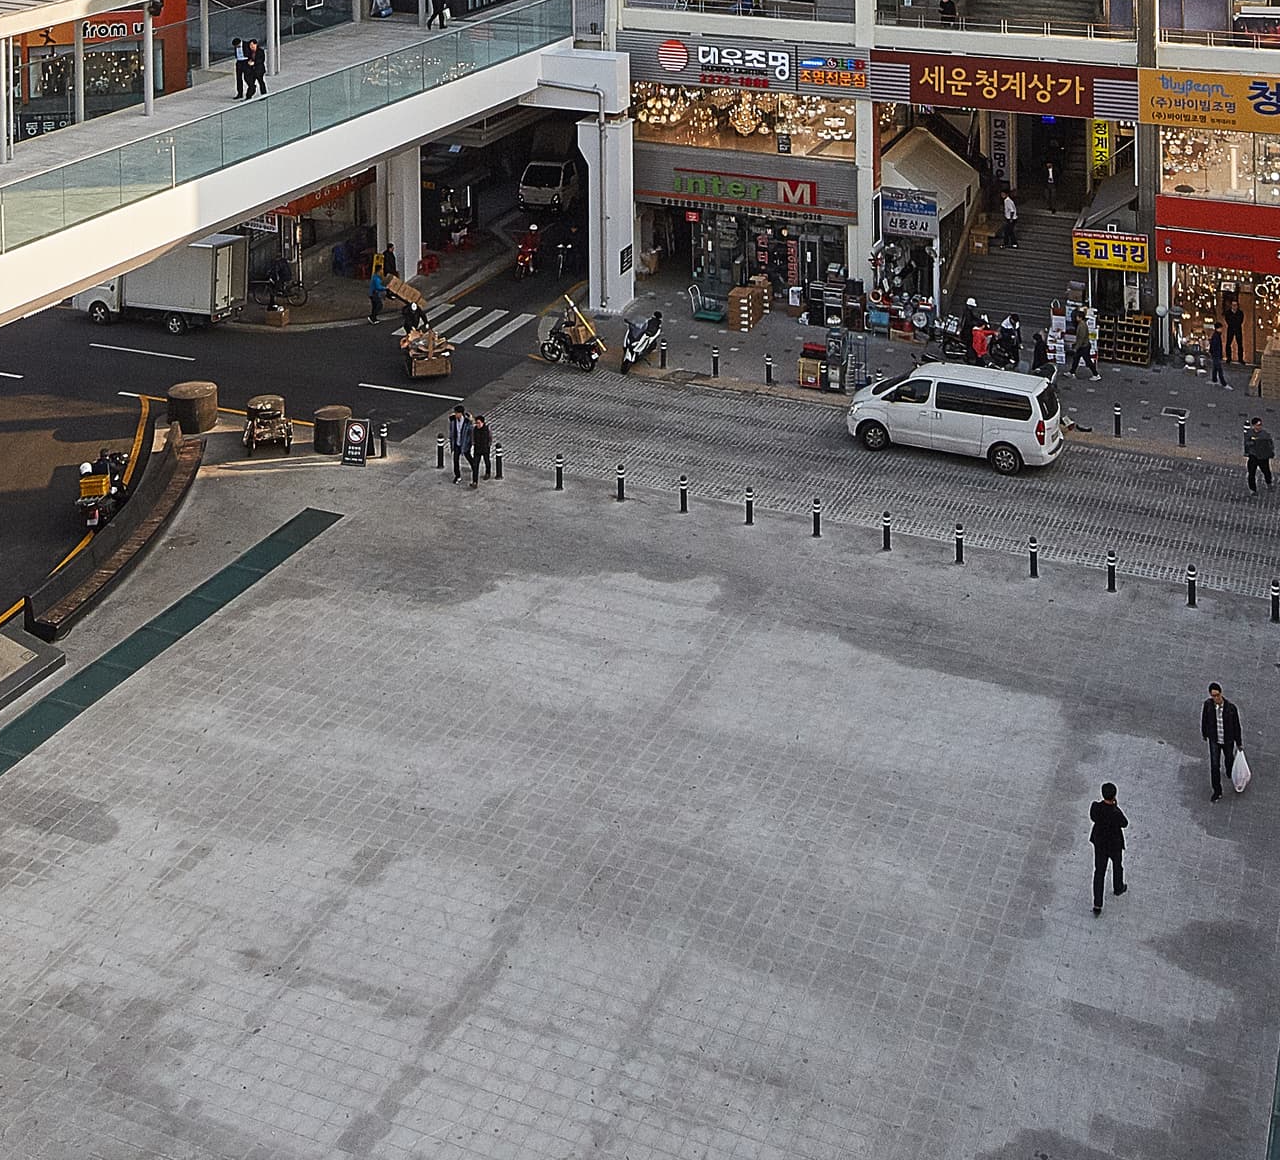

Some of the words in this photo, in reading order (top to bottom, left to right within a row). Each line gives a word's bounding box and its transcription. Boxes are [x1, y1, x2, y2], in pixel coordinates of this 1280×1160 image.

[82, 21, 128, 38] from
[698, 46, 790, 81] 대우조명
[800, 69, 866, 88] 조명전문점
[919, 65, 1085, 105] 세운청계상가
[673, 176, 765, 199] inter
[777, 181, 811, 205] M
[1076, 240, 1145, 263] 육교박킹
